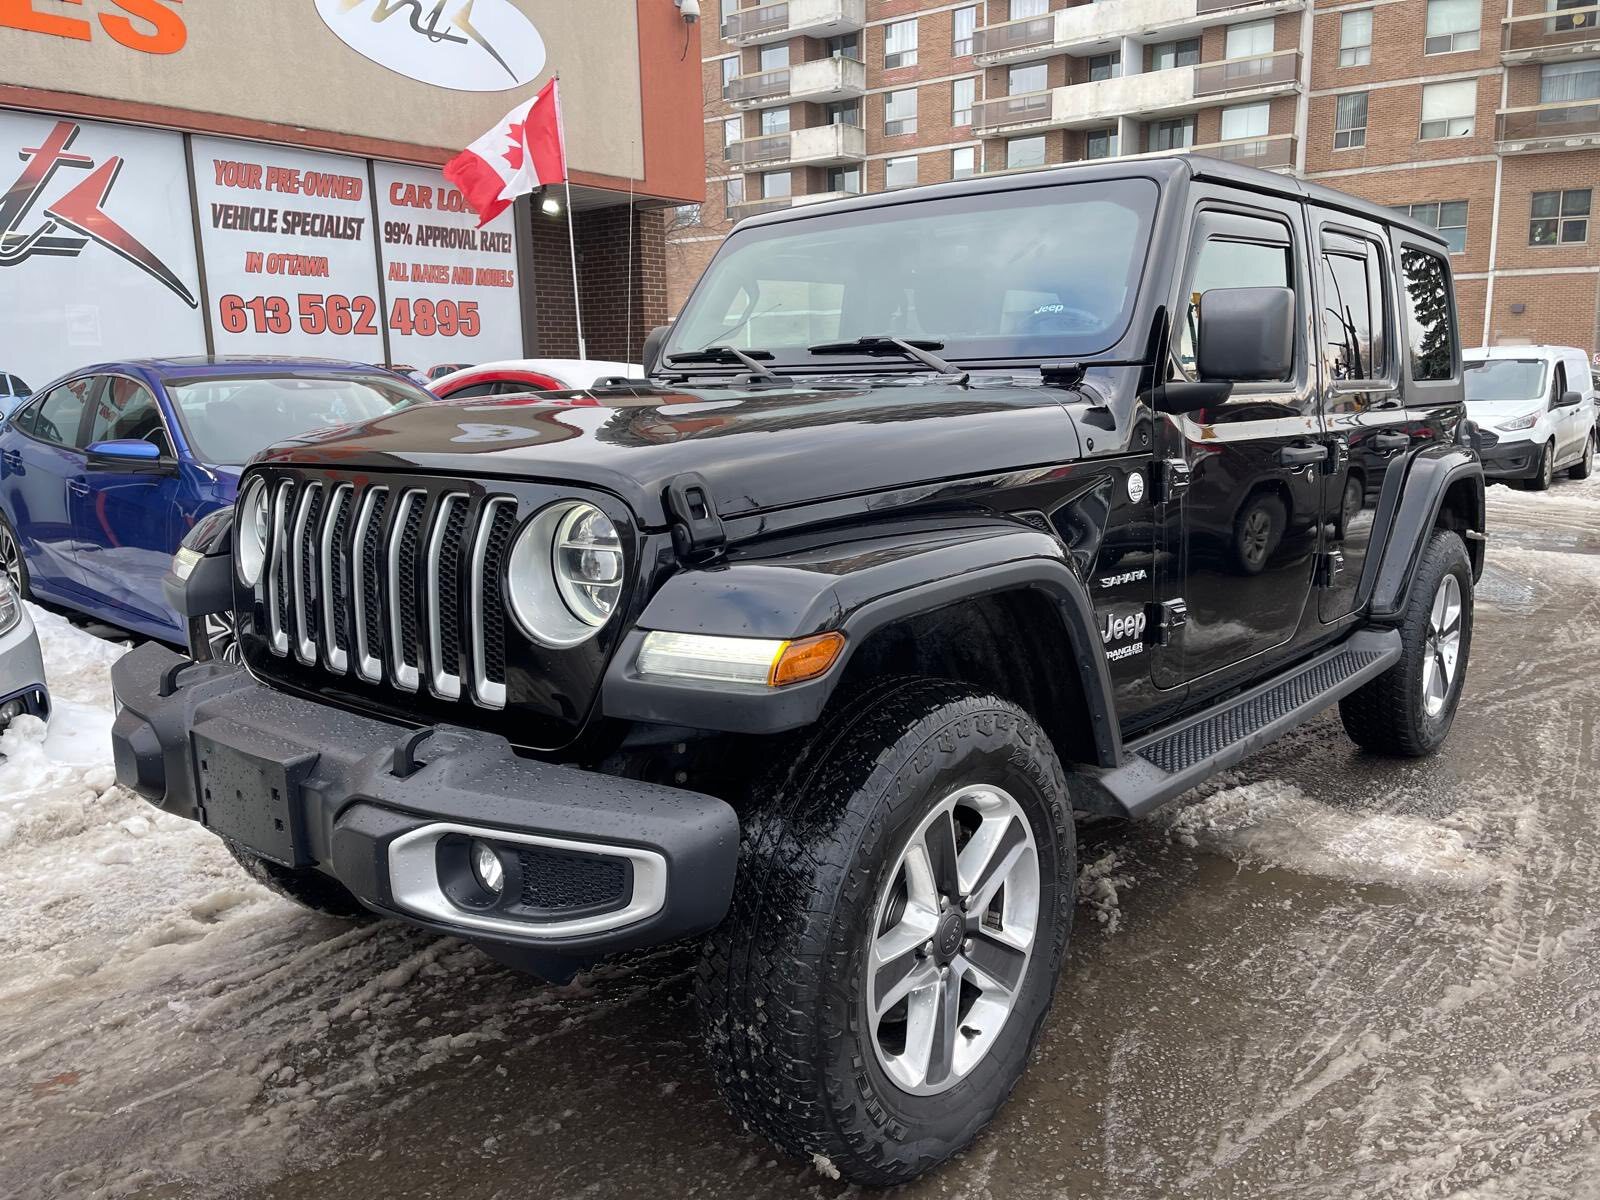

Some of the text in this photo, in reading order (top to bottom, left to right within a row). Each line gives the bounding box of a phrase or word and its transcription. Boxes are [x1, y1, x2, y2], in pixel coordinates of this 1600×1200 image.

[213, 159, 363, 201] YOUR PRE-OWNED
[389, 182, 480, 215] CAR LOA
[211, 203, 365, 241] VEHICLE SPECIALIST
[384, 221, 512, 253] 99% APPROVAL RATE!
[245, 251, 329, 277] IN OTTAWA
[388, 262, 514, 288] ALL MAKES AND MODELS
[219, 293, 481, 337] 613 562 4895
[1100, 569, 1147, 588] SAHARA
[1101, 612, 1146, 644] Jeep
[1105, 642, 1143, 660] RANGLER
